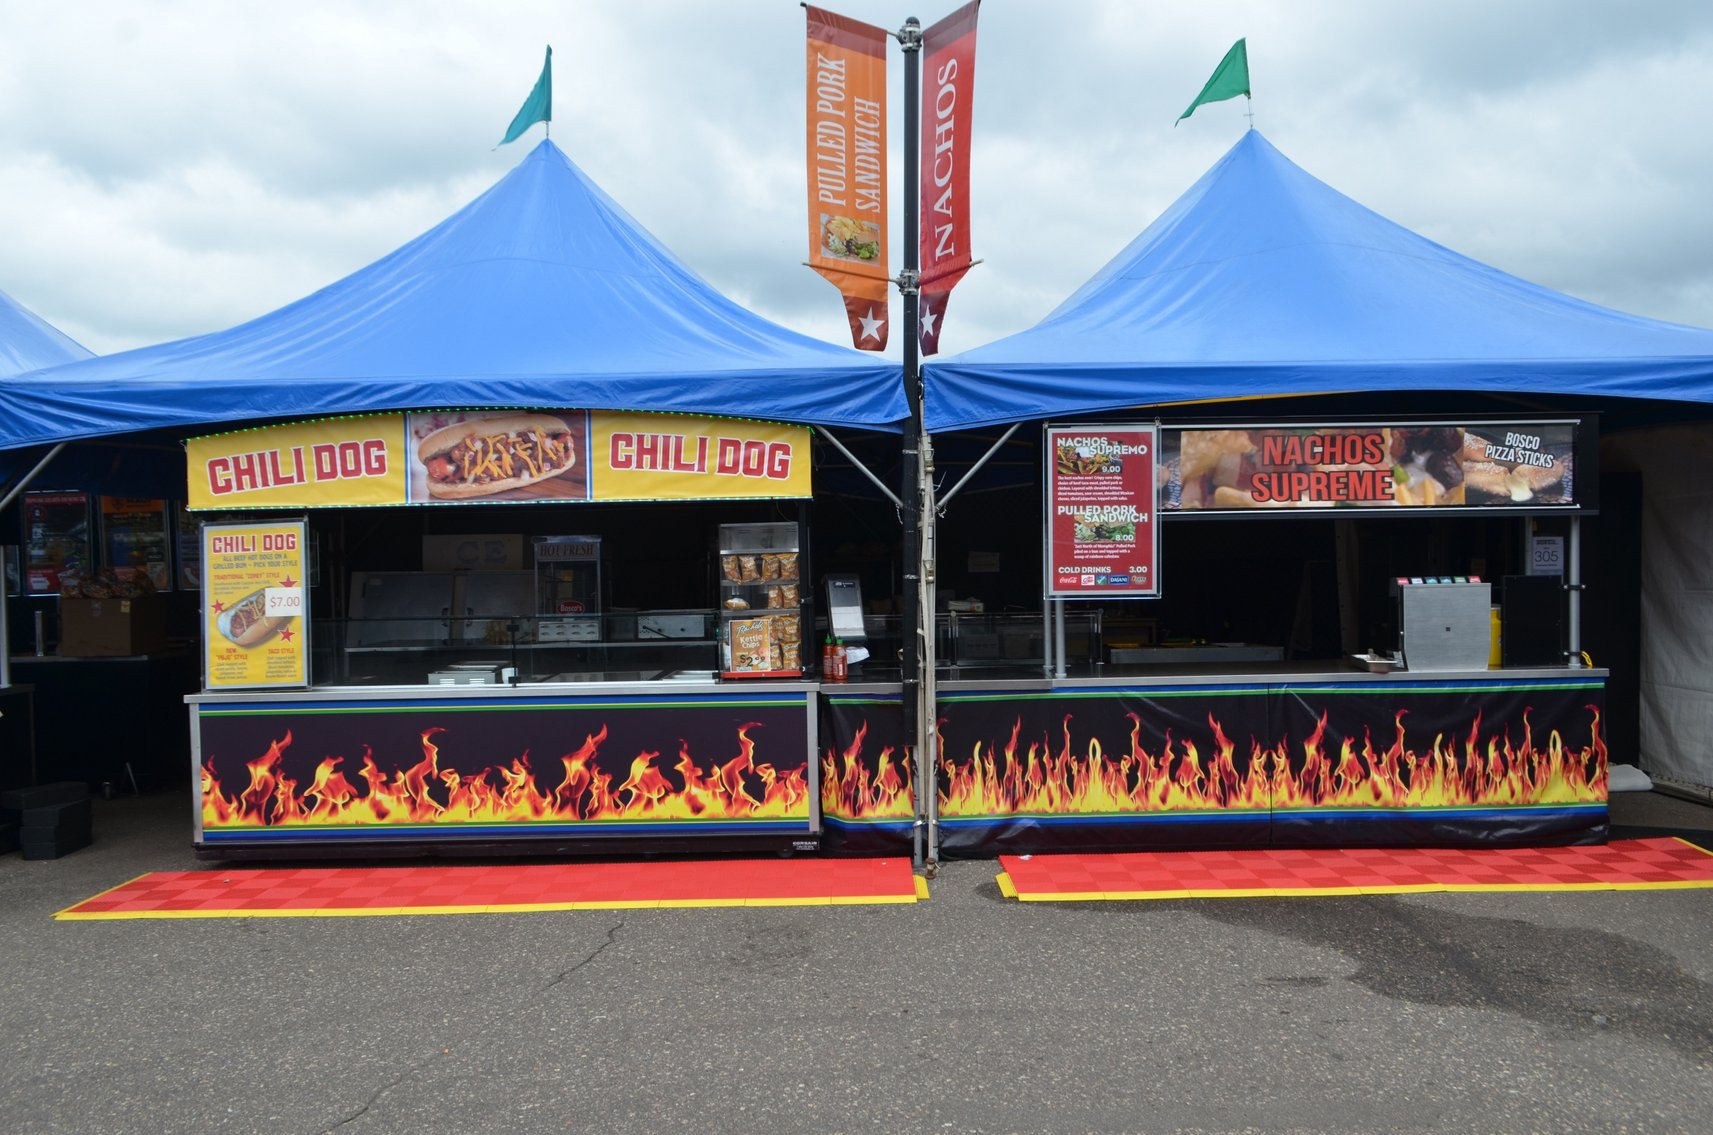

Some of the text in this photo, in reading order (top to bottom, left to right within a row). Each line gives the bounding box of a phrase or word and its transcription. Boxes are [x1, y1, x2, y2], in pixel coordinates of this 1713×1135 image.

[816, 52, 846, 207] PULLED PORK
[854, 96, 880, 214] SANDWICH
[934, 58, 958, 262] NACHOS
[1057, 437, 1108, 446] NACHOS
[1090, 445, 1148, 454] SUPREMO
[1262, 434, 1386, 466] NACHOS
[1504, 431, 1540, 451] BOSCO
[609, 432, 792, 480] CHILI DOG
[1485, 444, 1554, 468] PIZZA STICKS
[206, 438, 388, 496] CHILI DOG
[1250, 470, 1395, 502] SUPREME
[1058, 505, 1136, 515] PULLED PORK
[1084, 513, 1148, 522] SANDWICH
[212, 533, 296, 554] CHILI DOG
[564, 544, 594, 556] FRESH
[1534, 551, 1559, 563] 305
[270, 596, 300, 608] $7.00
[560, 604, 582, 612] Bosco's
[740, 634, 762, 644] Kettle
